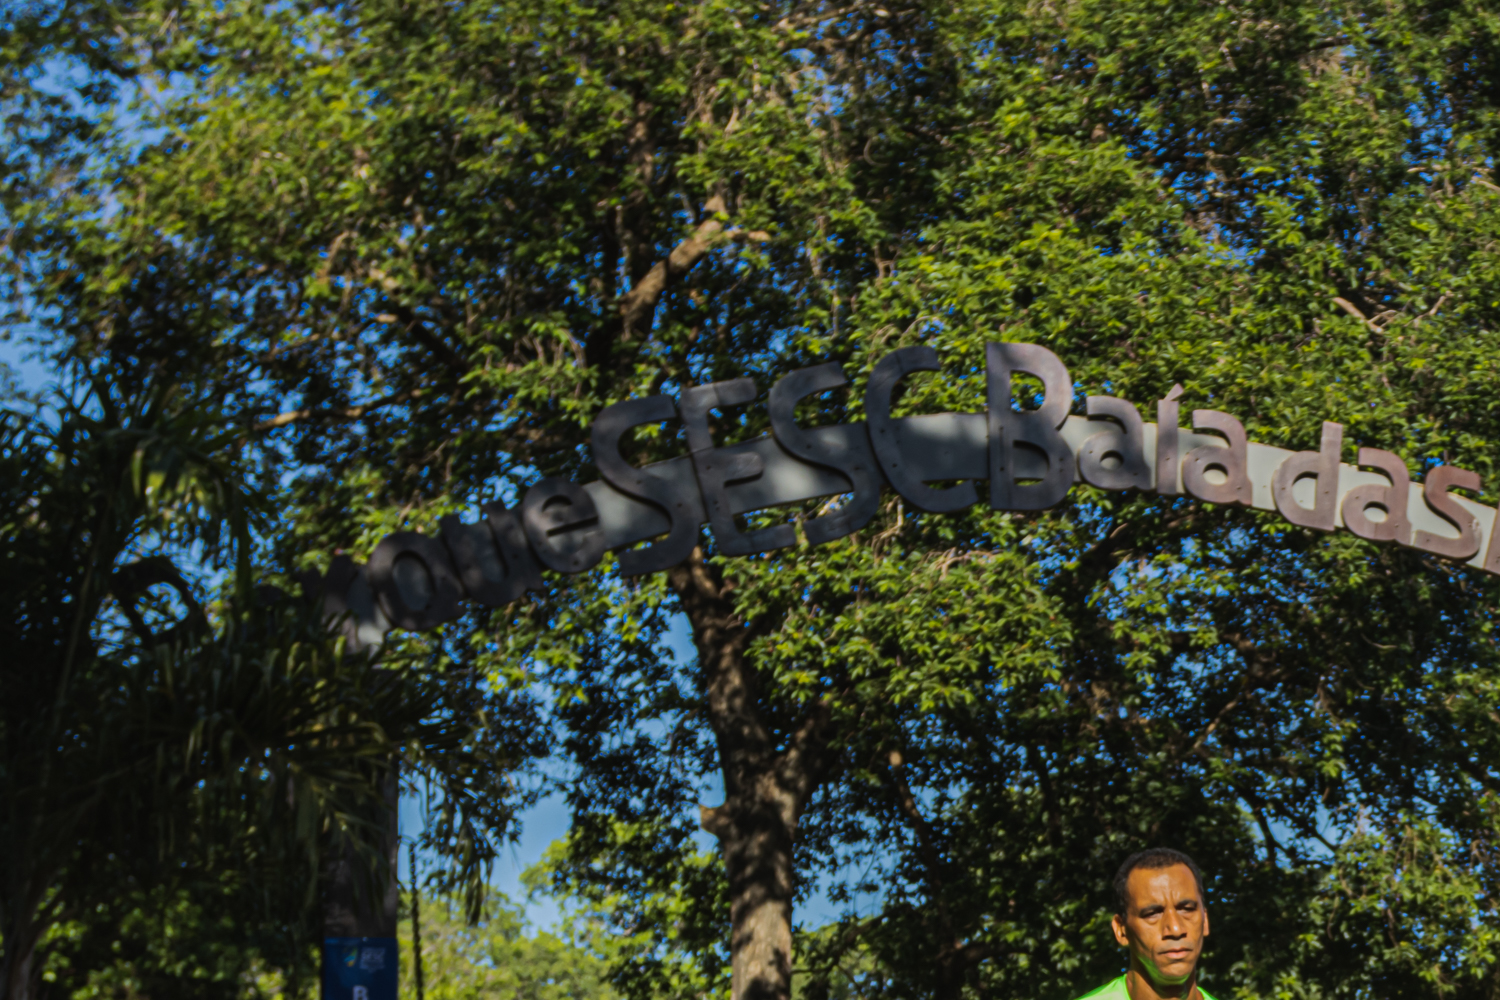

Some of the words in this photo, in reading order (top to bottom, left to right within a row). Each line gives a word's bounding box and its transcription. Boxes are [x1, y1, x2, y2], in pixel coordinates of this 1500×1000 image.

[592, 344, 977, 576] SESC
[985, 342, 1252, 511] Baía
[1271, 421, 1482, 560] das
